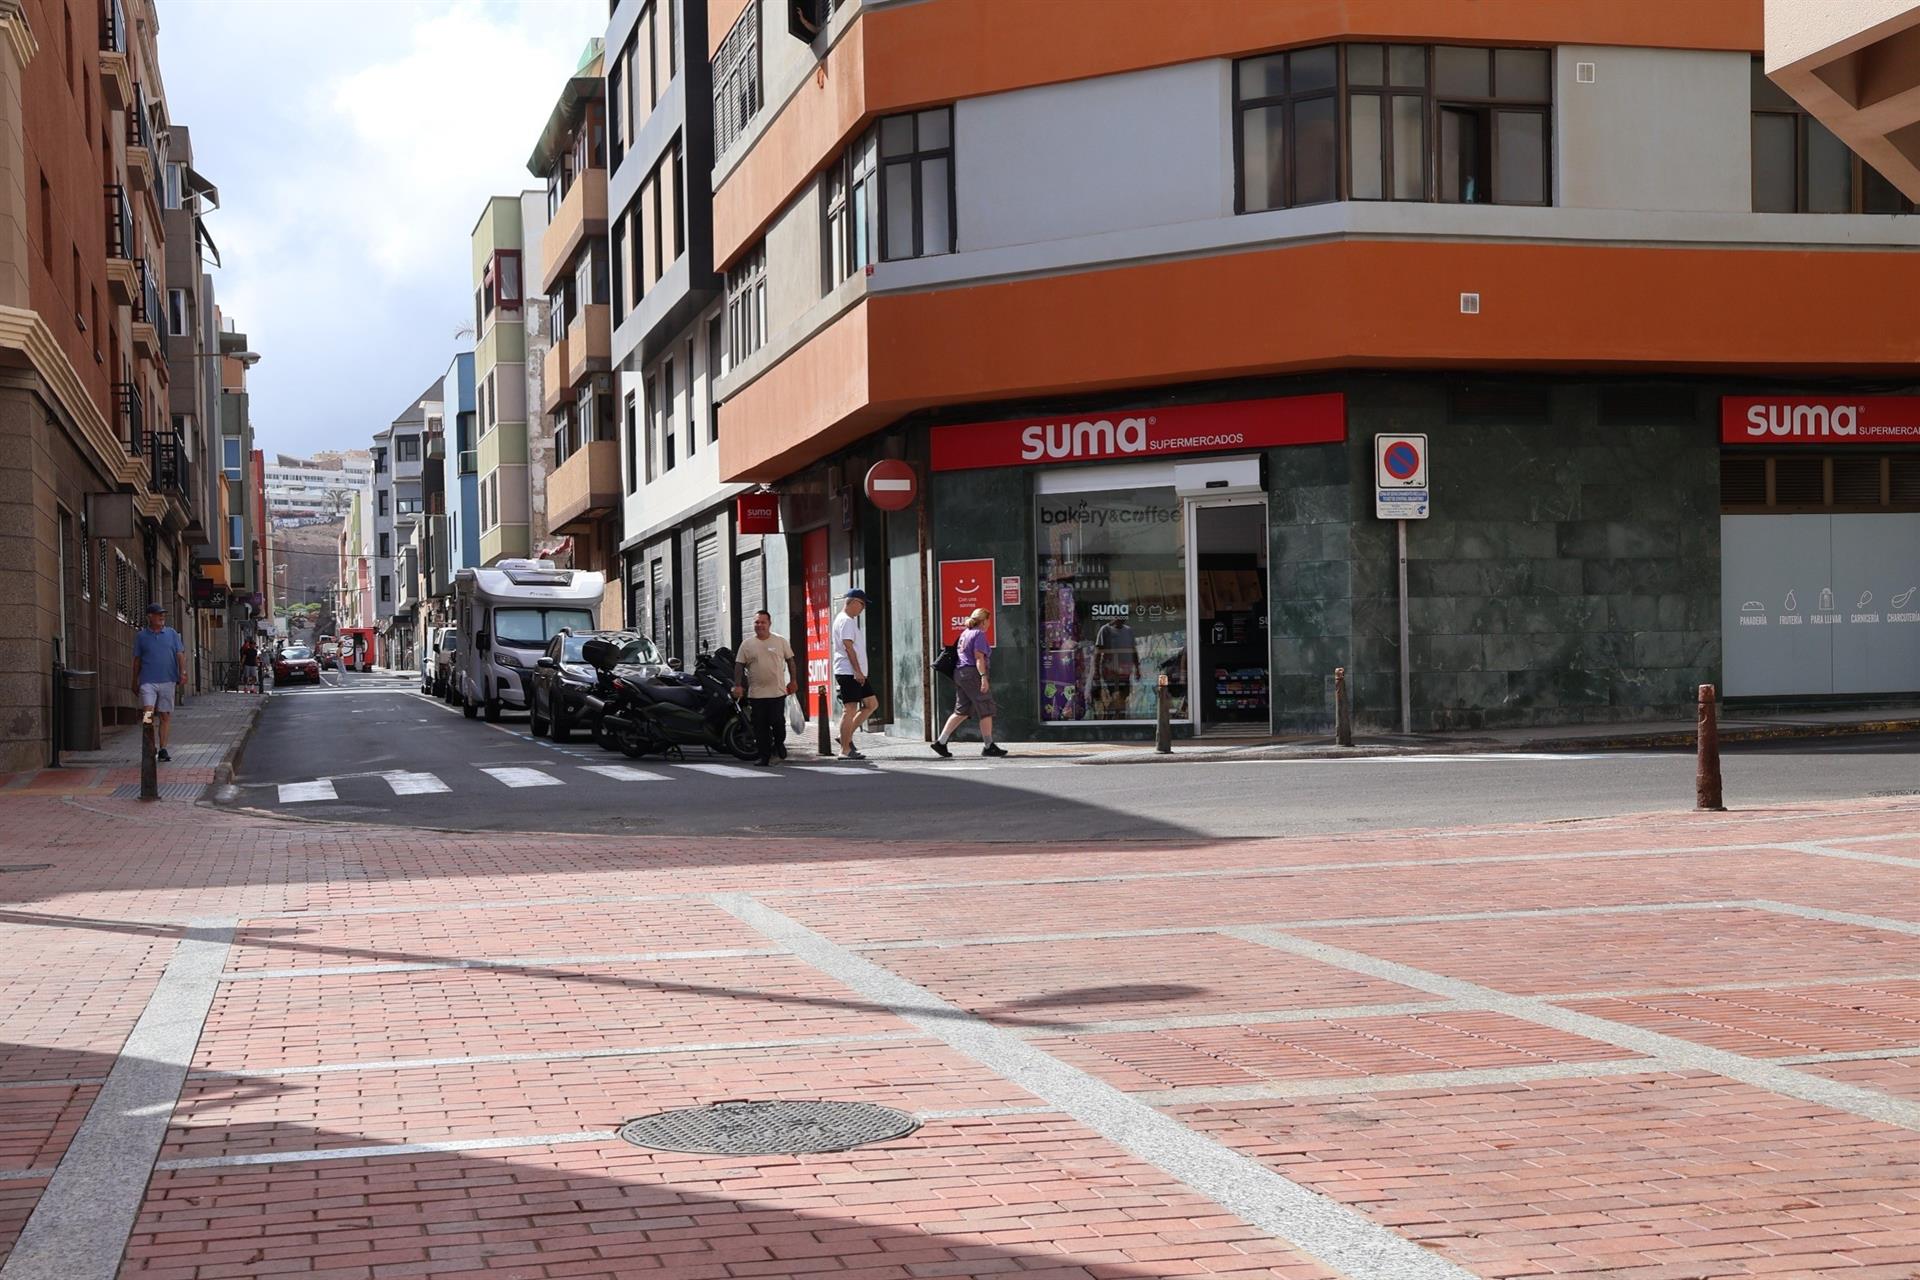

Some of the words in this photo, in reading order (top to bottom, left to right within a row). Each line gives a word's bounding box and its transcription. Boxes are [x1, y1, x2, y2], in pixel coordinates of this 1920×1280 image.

[1747, 405, 1857, 436] suma
[1021, 417, 1146, 460] suma
[1859, 426, 1920, 435] SUPERMERCA
[1149, 433, 1244, 450] SUPERMERCADOS
[1091, 604, 1129, 616] suma
